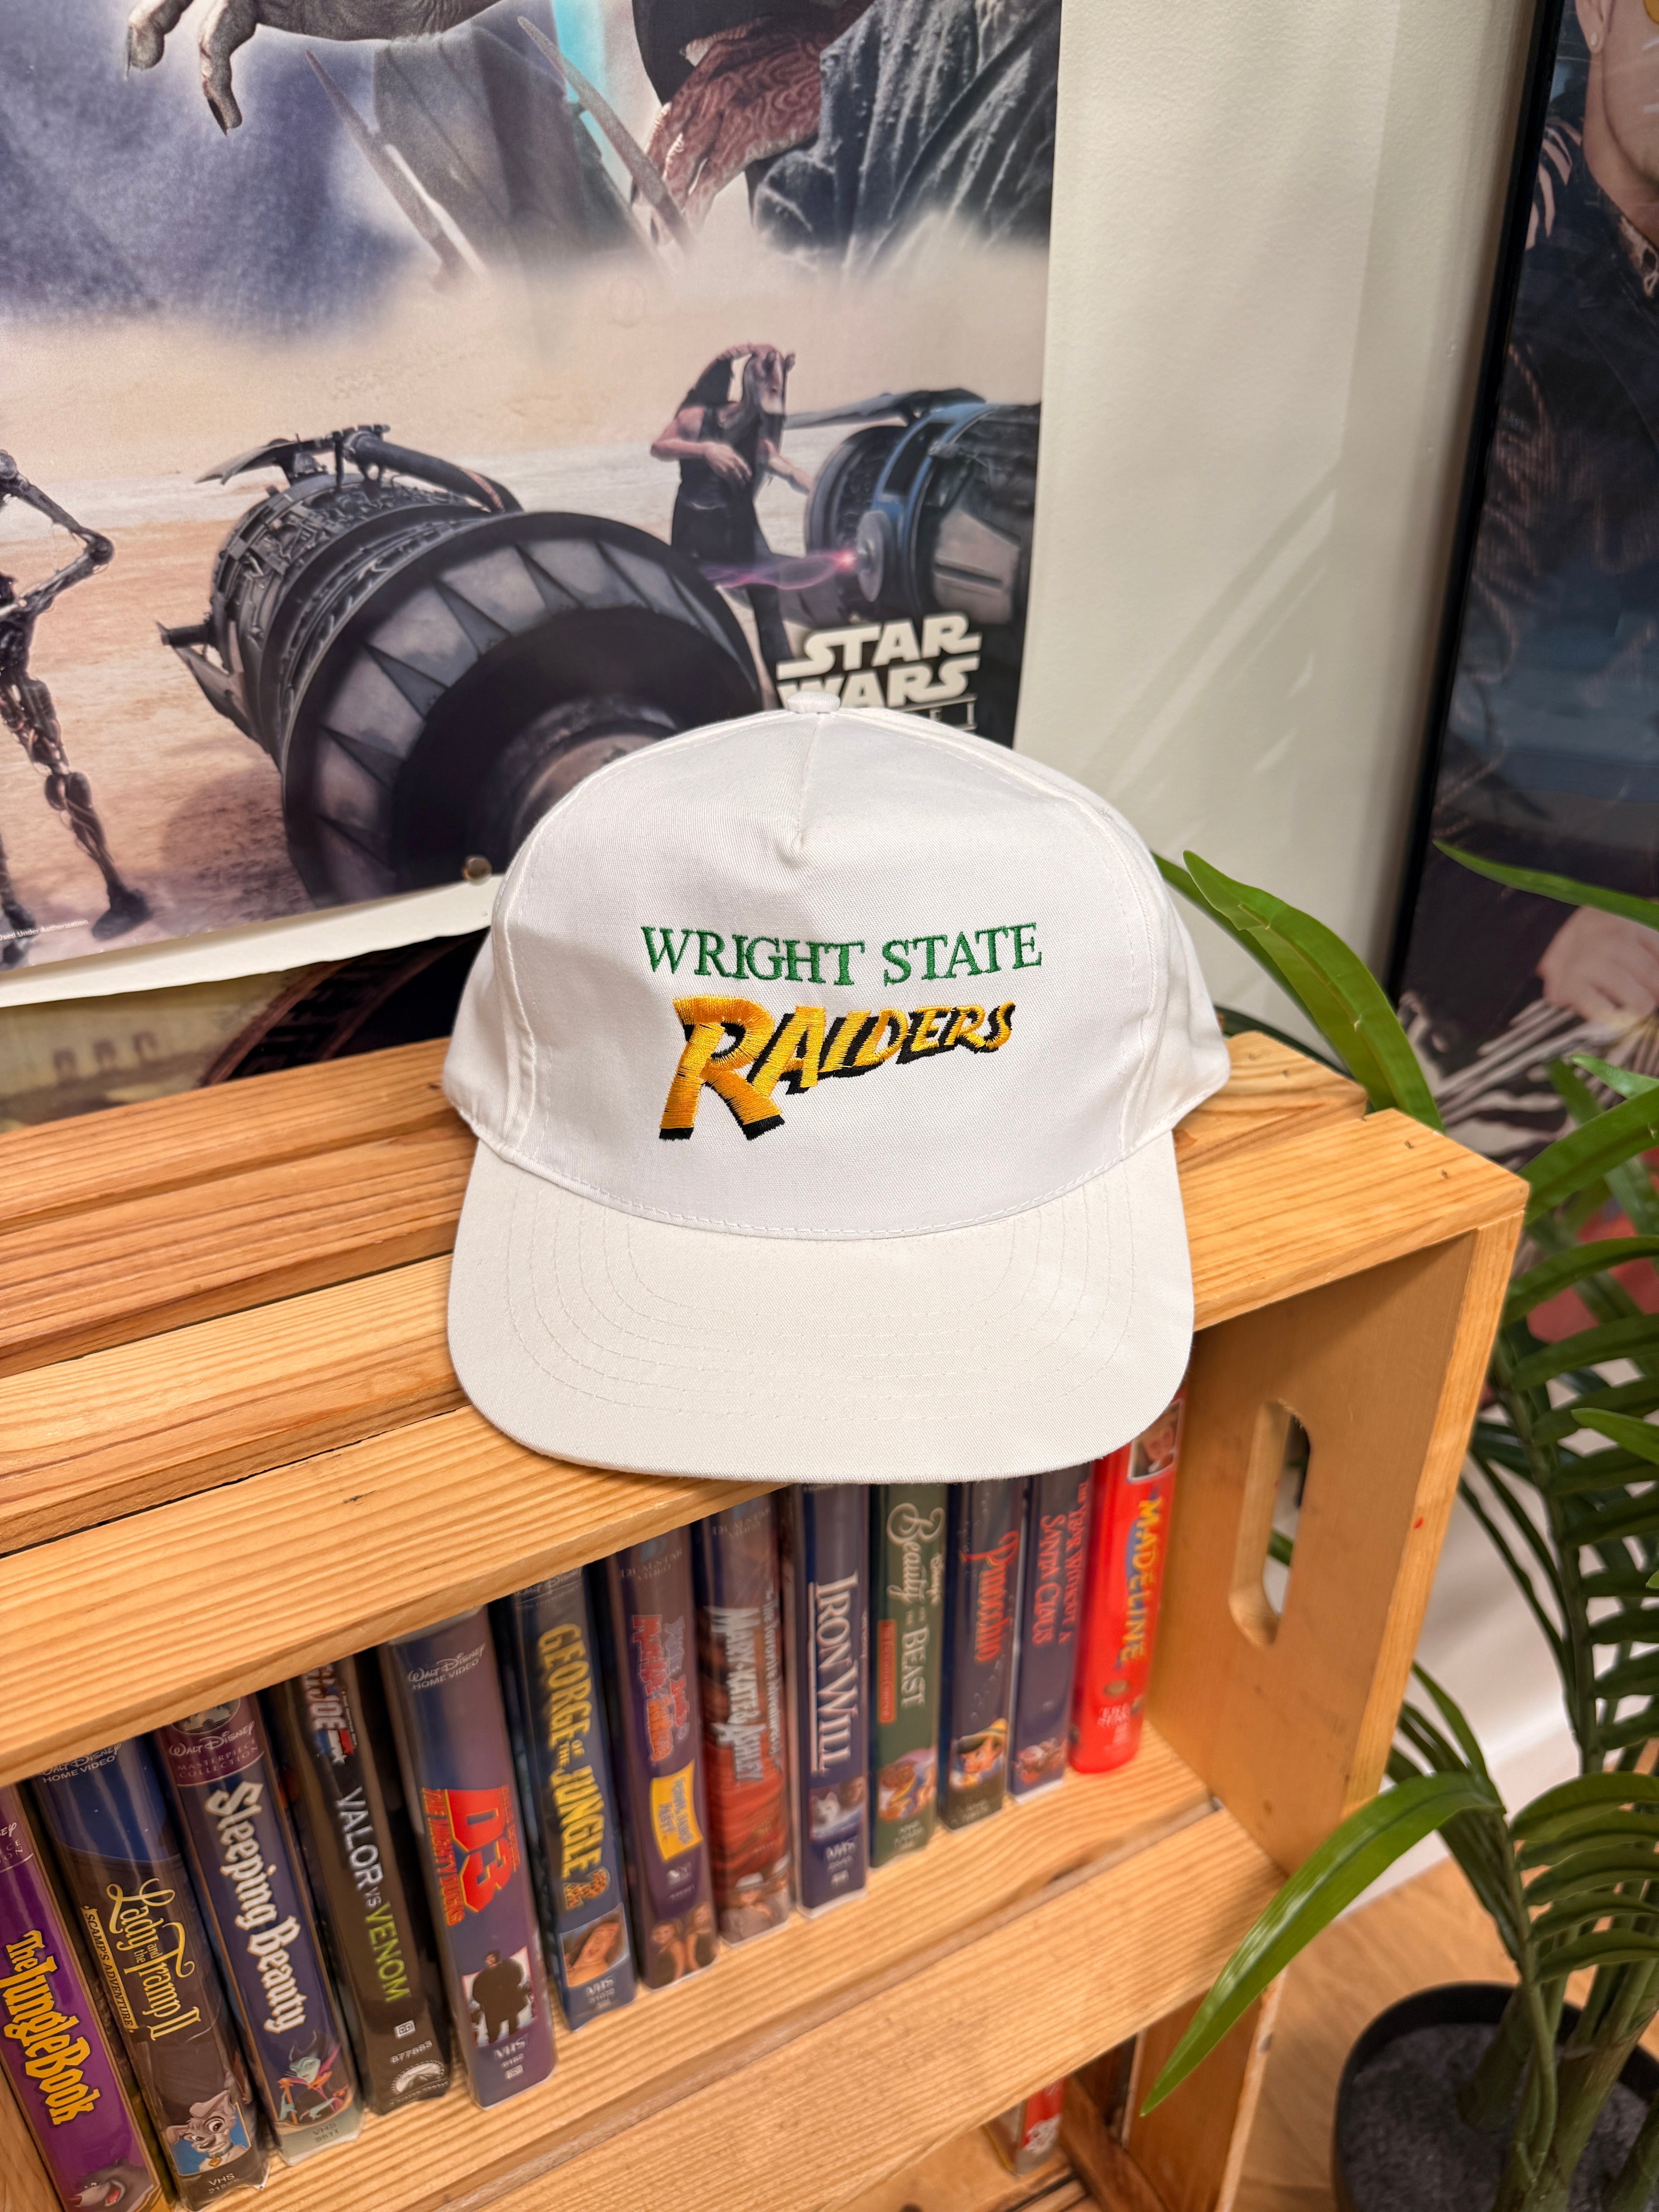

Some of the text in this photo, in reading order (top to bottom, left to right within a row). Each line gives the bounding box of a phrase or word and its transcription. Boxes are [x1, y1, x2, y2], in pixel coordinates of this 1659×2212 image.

[777, 612, 983, 680] STAR
[17, 928, 39, 938] Under
[40, 919, 90, 932] Authorization.
[640, 922, 1042, 986] WRIGHT STATE
[659, 995, 1016, 1140] RAIDERS
[887, 1503, 945, 1605] Beauty
[1066, 1502, 1086, 1553] YEAR
[959, 1531, 1019, 1662] Pinocchio
[1032, 1514, 1066, 1645] SANTA CLAUS
[1062, 1548, 1081, 1625] WITHOUT
[1119, 1495, 1163, 1662] MADELINE
[408, 1643, 486, 1682] WALT DISNEY
[412, 1658, 479, 1690] HOME VIDEO
[538, 1623, 592, 1751] GEORGE
[816, 1568, 858, 1771] IRON WILL
[901, 1624, 930, 1709] BEAST
[43, 1755, 115, 1783] HOME VIDEO
[169, 1721, 255, 1757] WALT DISNEY
[179, 1744, 258, 1778] COLLECTION
[711, 1723, 766, 1781] ASHLEY
[428, 1817, 458, 1874] MIGHTY
[444, 1789, 512, 1913] D3
[550, 1765, 604, 1879] JUNGLE
[204, 1781, 307, 2034] Sleeping Beauty
[335, 1786, 383, 1891] VALOR
[365, 1901, 411, 2003] VENOM
[439, 1874, 466, 1926] DUCKS
[563, 1866, 610, 1910] 2
[86, 1913, 133, 2026] SCAMP'S ADVENTURE
[107, 1878, 201, 2041] Lady and the Tramp II
[0, 1930, 101, 2125] The Jungle Book
[313, 2122, 337, 2135] VHS
[208, 2173, 235, 2186] VHS
